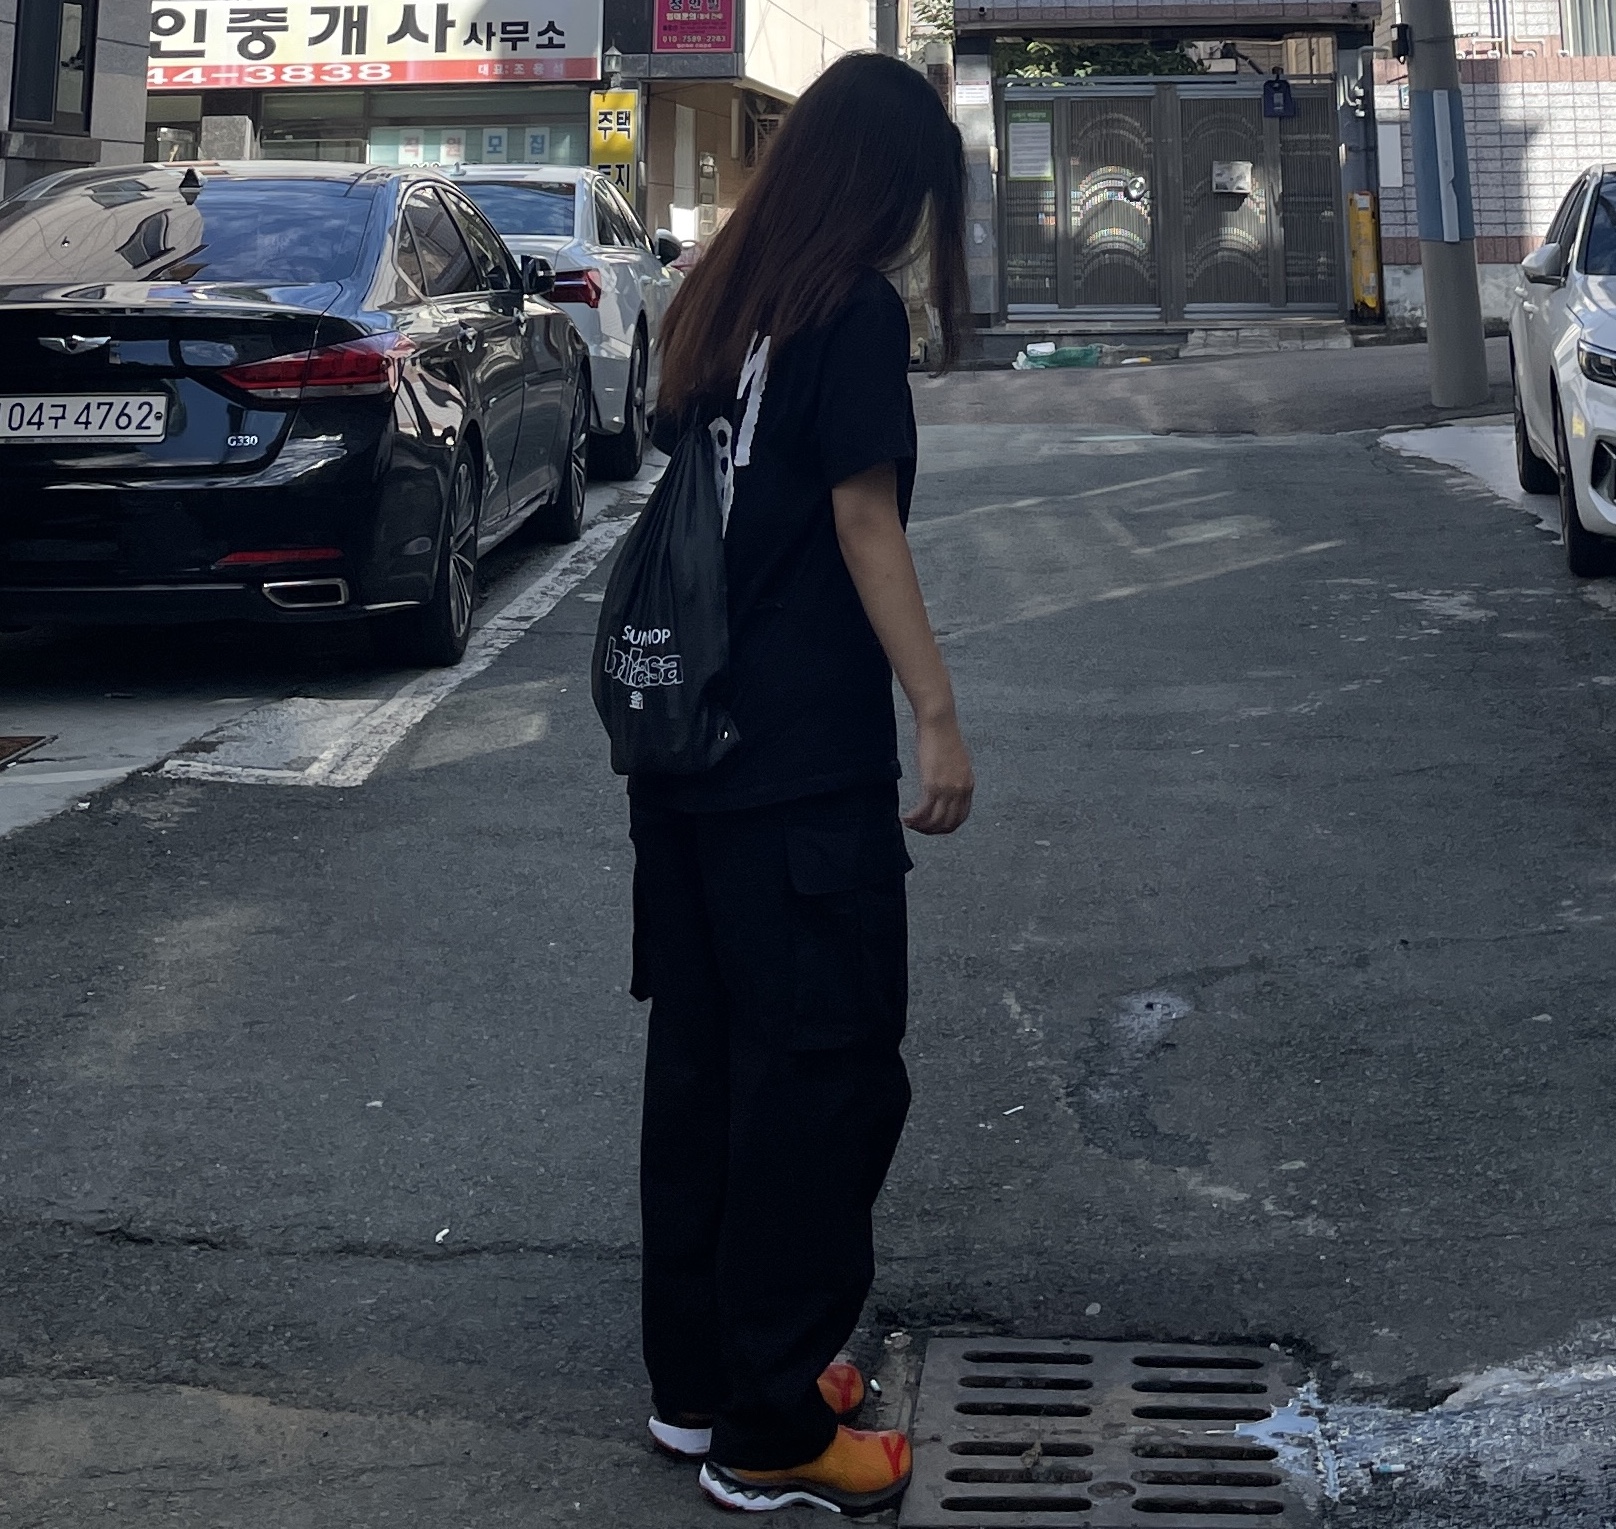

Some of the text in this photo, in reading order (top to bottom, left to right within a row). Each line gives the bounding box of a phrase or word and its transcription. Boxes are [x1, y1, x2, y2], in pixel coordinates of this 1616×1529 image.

[463, 20, 566, 51] 사무소
[598, 110, 631, 140] 주택
[0, 401, 154, 431] 04구 4762
[227, 435, 259, 447] G330
